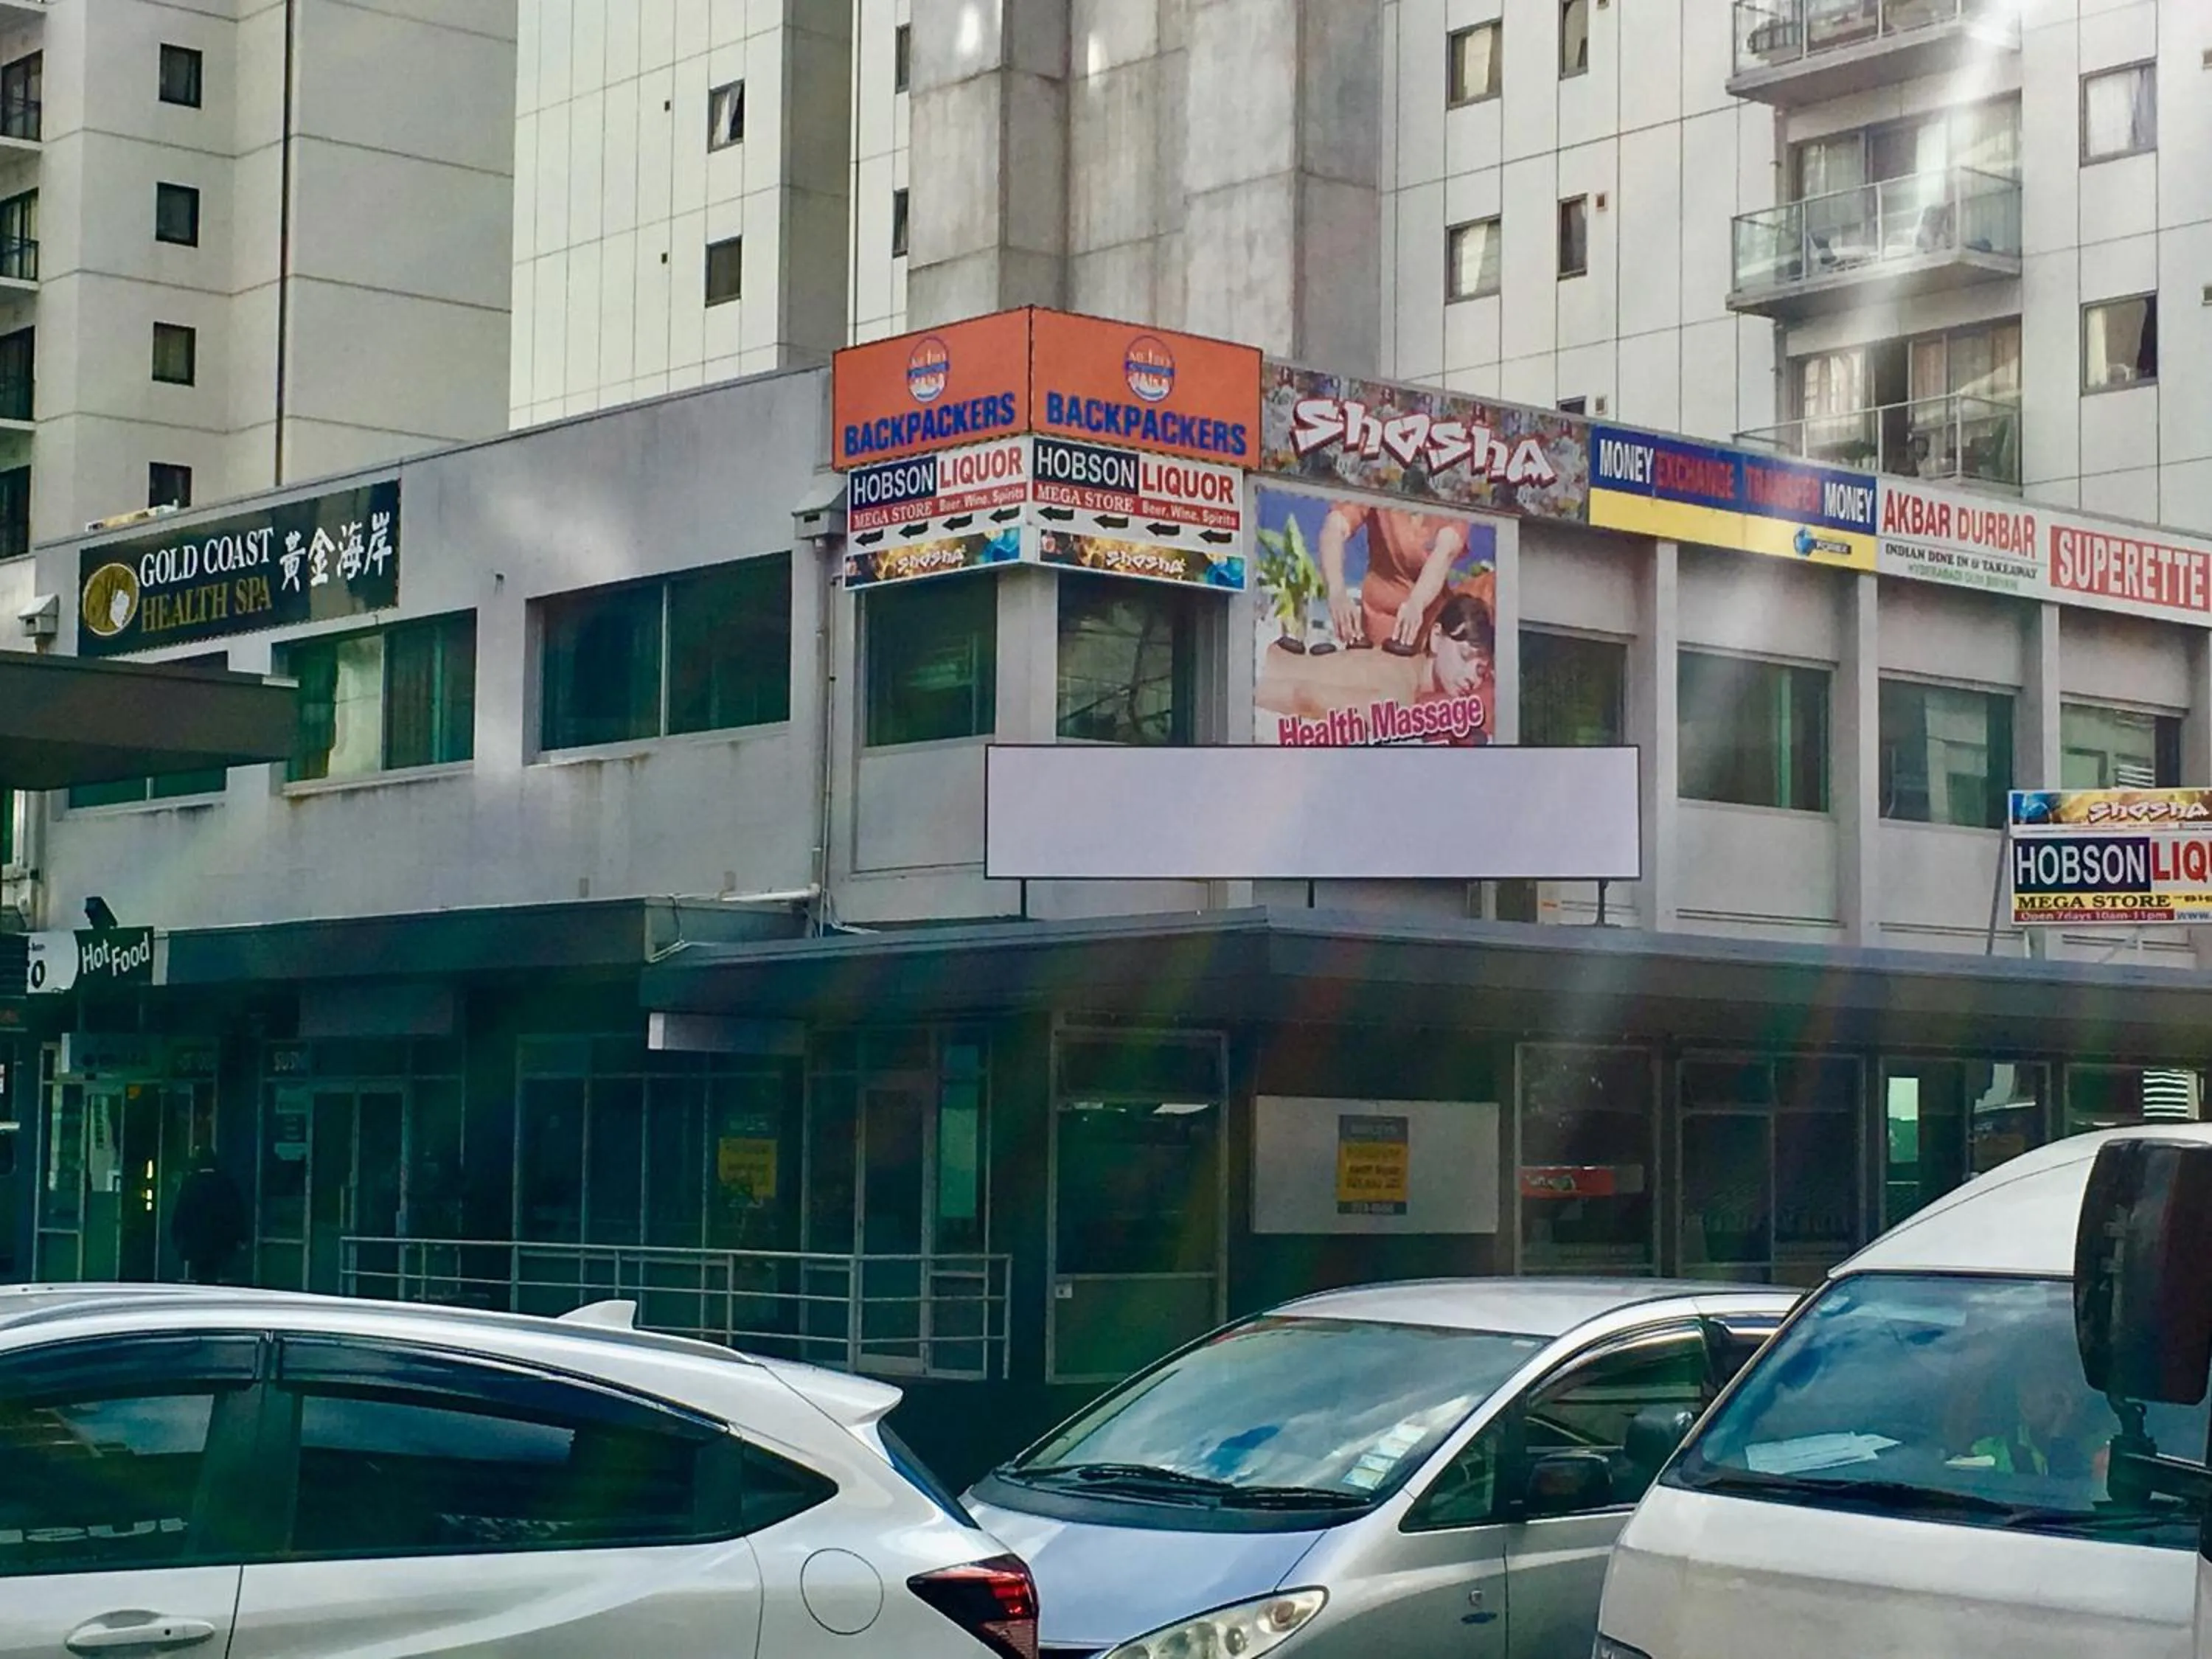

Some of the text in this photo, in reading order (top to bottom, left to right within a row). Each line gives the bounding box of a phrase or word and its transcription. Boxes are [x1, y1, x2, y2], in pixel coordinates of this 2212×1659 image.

[844, 393, 1015, 457] BACKPACKERS
[1047, 391, 1246, 456] BACKPACKERS
[854, 445, 1023, 506] HOBSON LIQUOR
[1037, 445, 1234, 504] HOBSON LIQUOR
[1599, 438, 1874, 524] MONEY EXCHANGE TRANSFER MONEY
[854, 509, 888, 527] MEGA
[892, 501, 933, 523] STORE
[992, 487, 1024, 504] Spirits
[1037, 484, 1081, 505] MEGA
[1084, 492, 1133, 512] STORE
[1203, 509, 1237, 526] Spirits
[1883, 489, 2036, 560] AKBAR DURBAR
[140, 527, 274, 587] GOLD COAST
[1885, 543, 1924, 560] INDIAN
[1927, 550, 1954, 565] DINE
[1956, 555, 1968, 567] IN
[1982, 560, 2038, 579] TAKEAWAY
[2059, 530, 2205, 608] SUPERETTE
[142, 575, 272, 633] HEALTH SPA
[1278, 696, 1484, 745] Health Massage
[2017, 841, 2212, 885] HOBSON LIQ
[2018, 896, 2085, 909] MEGA
[2093, 895, 2171, 908] STORE
[2021, 911, 2055, 922] Open
[81, 931, 150, 976] Hot Food
